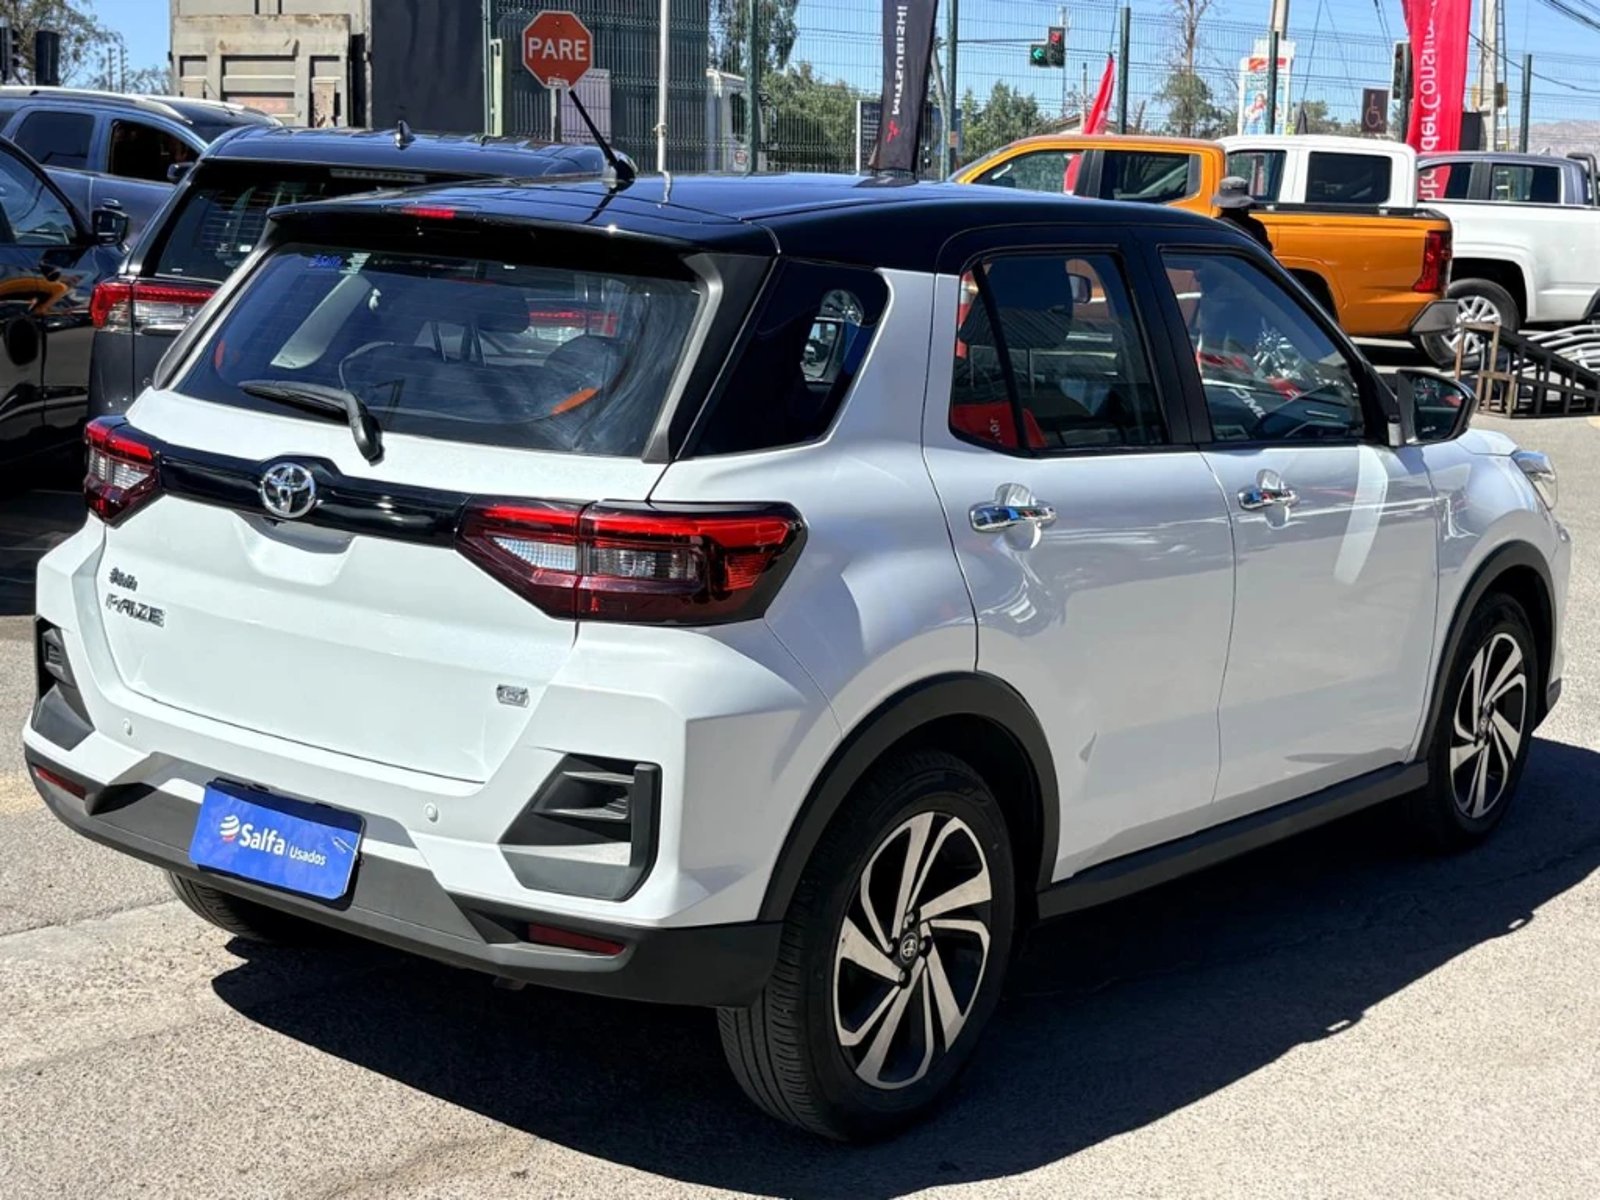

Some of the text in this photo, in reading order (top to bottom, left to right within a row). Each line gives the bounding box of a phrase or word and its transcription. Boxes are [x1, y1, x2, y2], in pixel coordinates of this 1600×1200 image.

[527, 36, 588, 61] PARE
[238, 823, 327, 866] Salfa Usados
